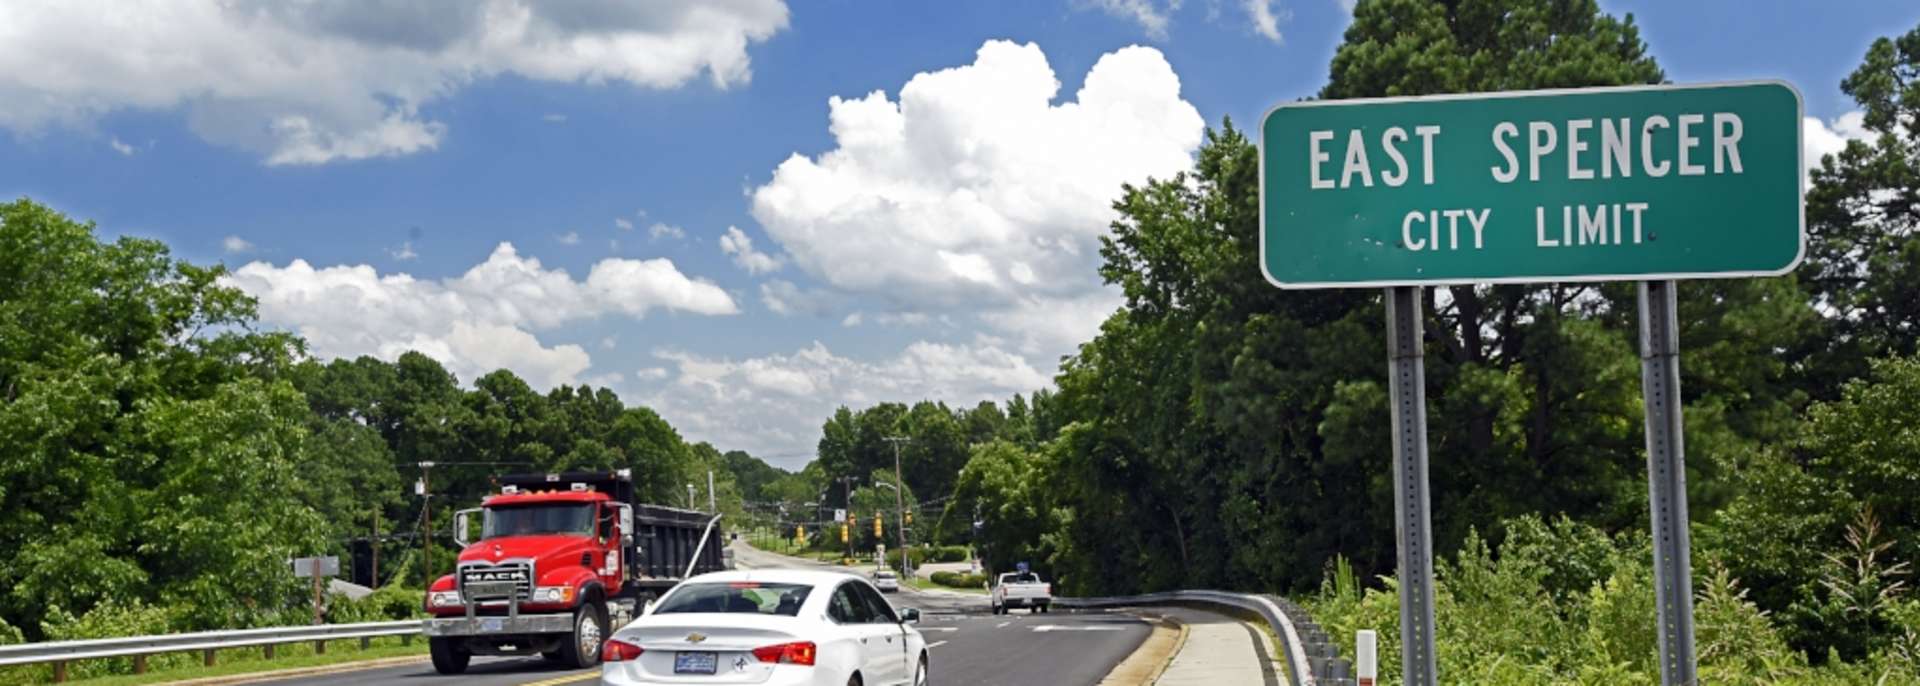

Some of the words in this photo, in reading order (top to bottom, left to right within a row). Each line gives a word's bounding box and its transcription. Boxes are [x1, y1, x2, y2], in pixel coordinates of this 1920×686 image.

[1310, 125, 1441, 189] EAST
[1491, 112, 1744, 183] SPENCER
[1402, 208, 1491, 251] CITY
[1536, 202, 1649, 247] LIMIT
[465, 571, 528, 581] MACK
